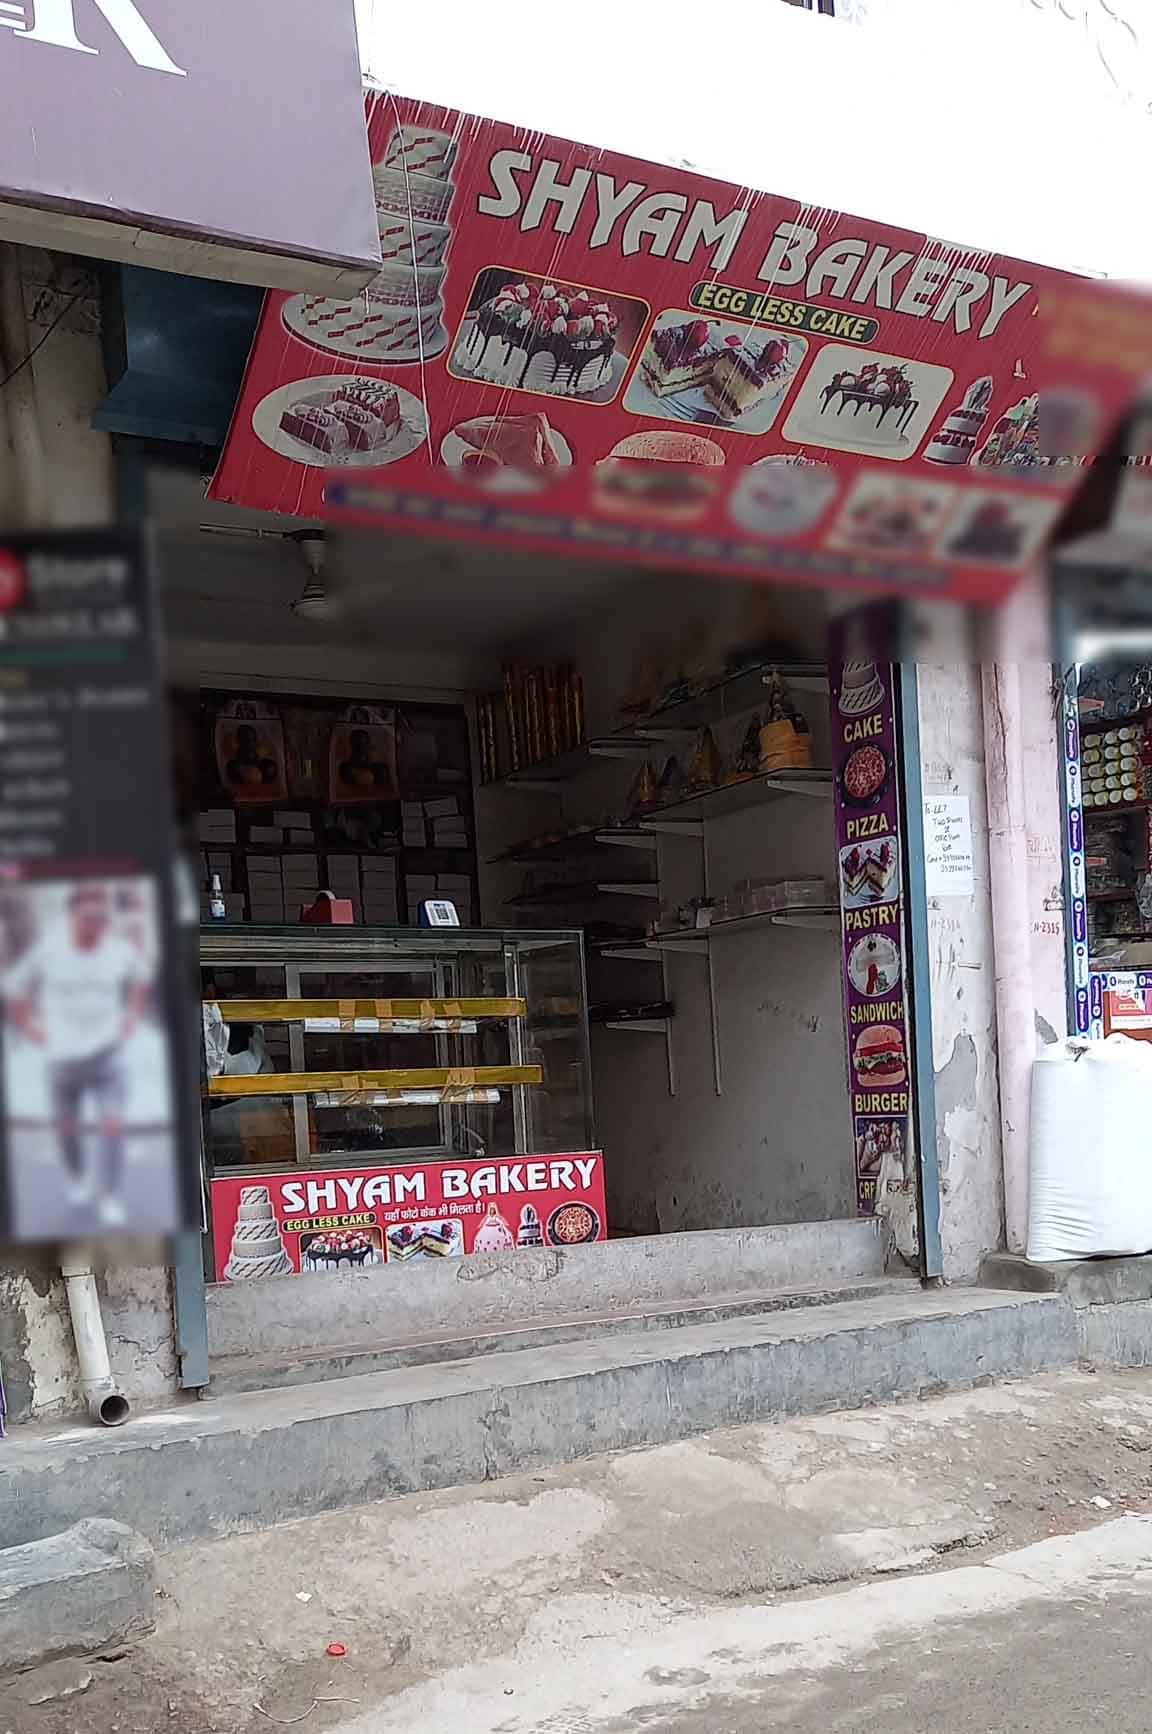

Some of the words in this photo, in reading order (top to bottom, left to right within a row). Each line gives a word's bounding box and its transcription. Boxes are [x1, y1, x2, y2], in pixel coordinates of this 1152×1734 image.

[478, 150, 750, 272] SHYAM
[758, 221, 1033, 340] BAKERY
[698, 284, 747, 312] EGG
[751, 295, 806, 326] LESS
[809, 309, 869, 339] CAKE
[844, 714, 883, 742] CAKE
[847, 813, 889, 839] PIZZA
[845, 904, 898, 931] PASTRY
[850, 1001, 904, 1024] SANDWICH
[855, 1093, 908, 1112] BURGER
[281, 1172, 425, 1214] SHYAM
[441, 1158, 597, 1199] BAKERY
[287, 1220, 309, 1231] EGG
[313, 1216, 338, 1228] LESS
[342, 1214, 371, 1225] CAKE
